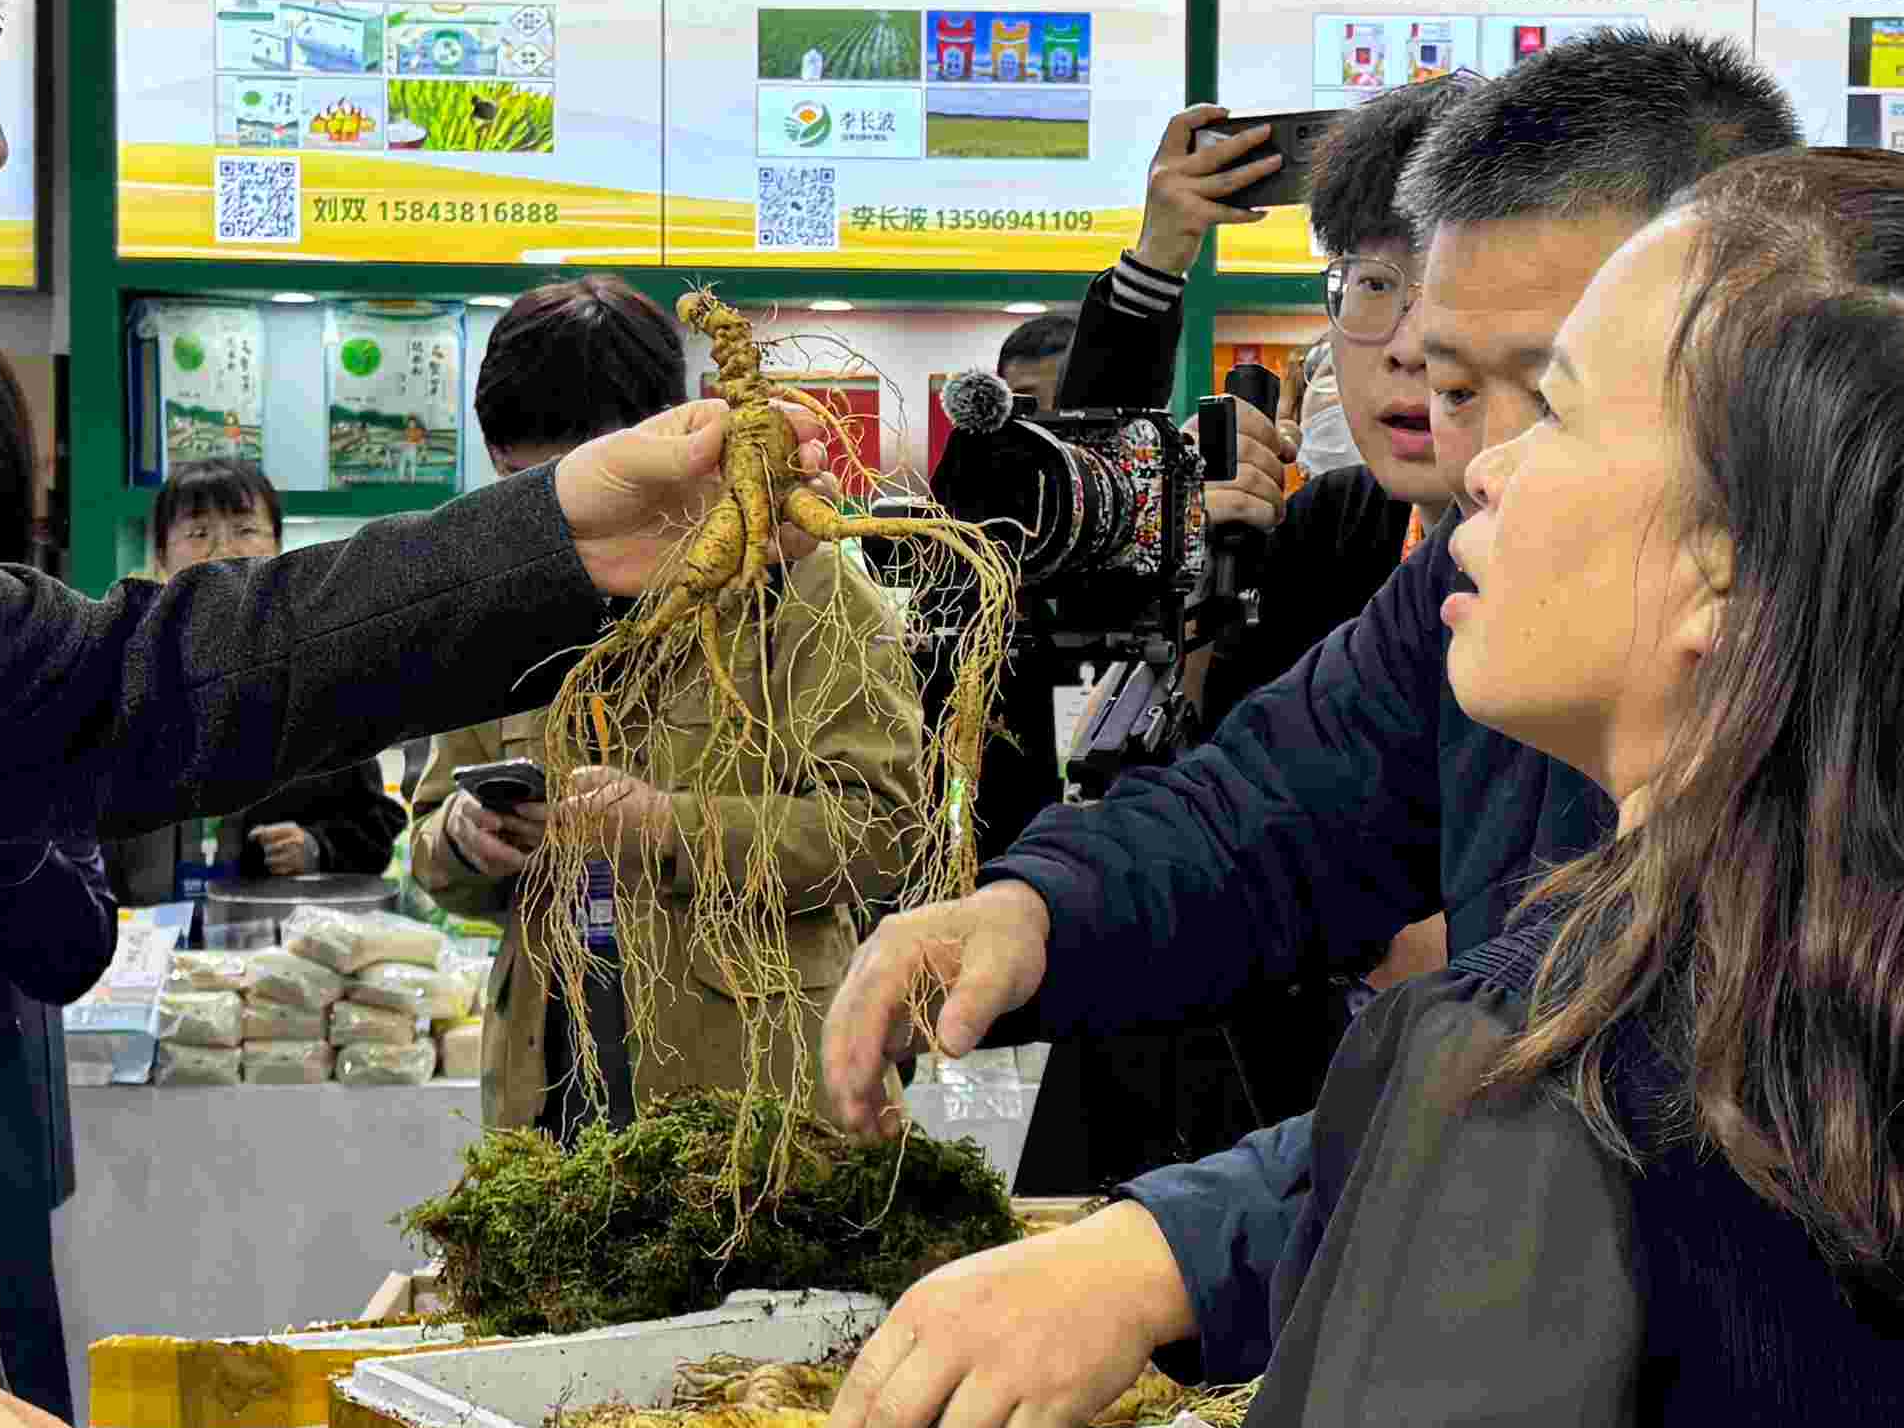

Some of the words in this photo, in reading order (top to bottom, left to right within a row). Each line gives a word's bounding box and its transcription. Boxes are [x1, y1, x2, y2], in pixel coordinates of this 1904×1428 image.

[312, 196, 368, 223] 刘双
[379, 198, 559, 224] 15843816888
[850, 205, 928, 232] 李长波
[936, 209, 1094, 232] 13596941109
